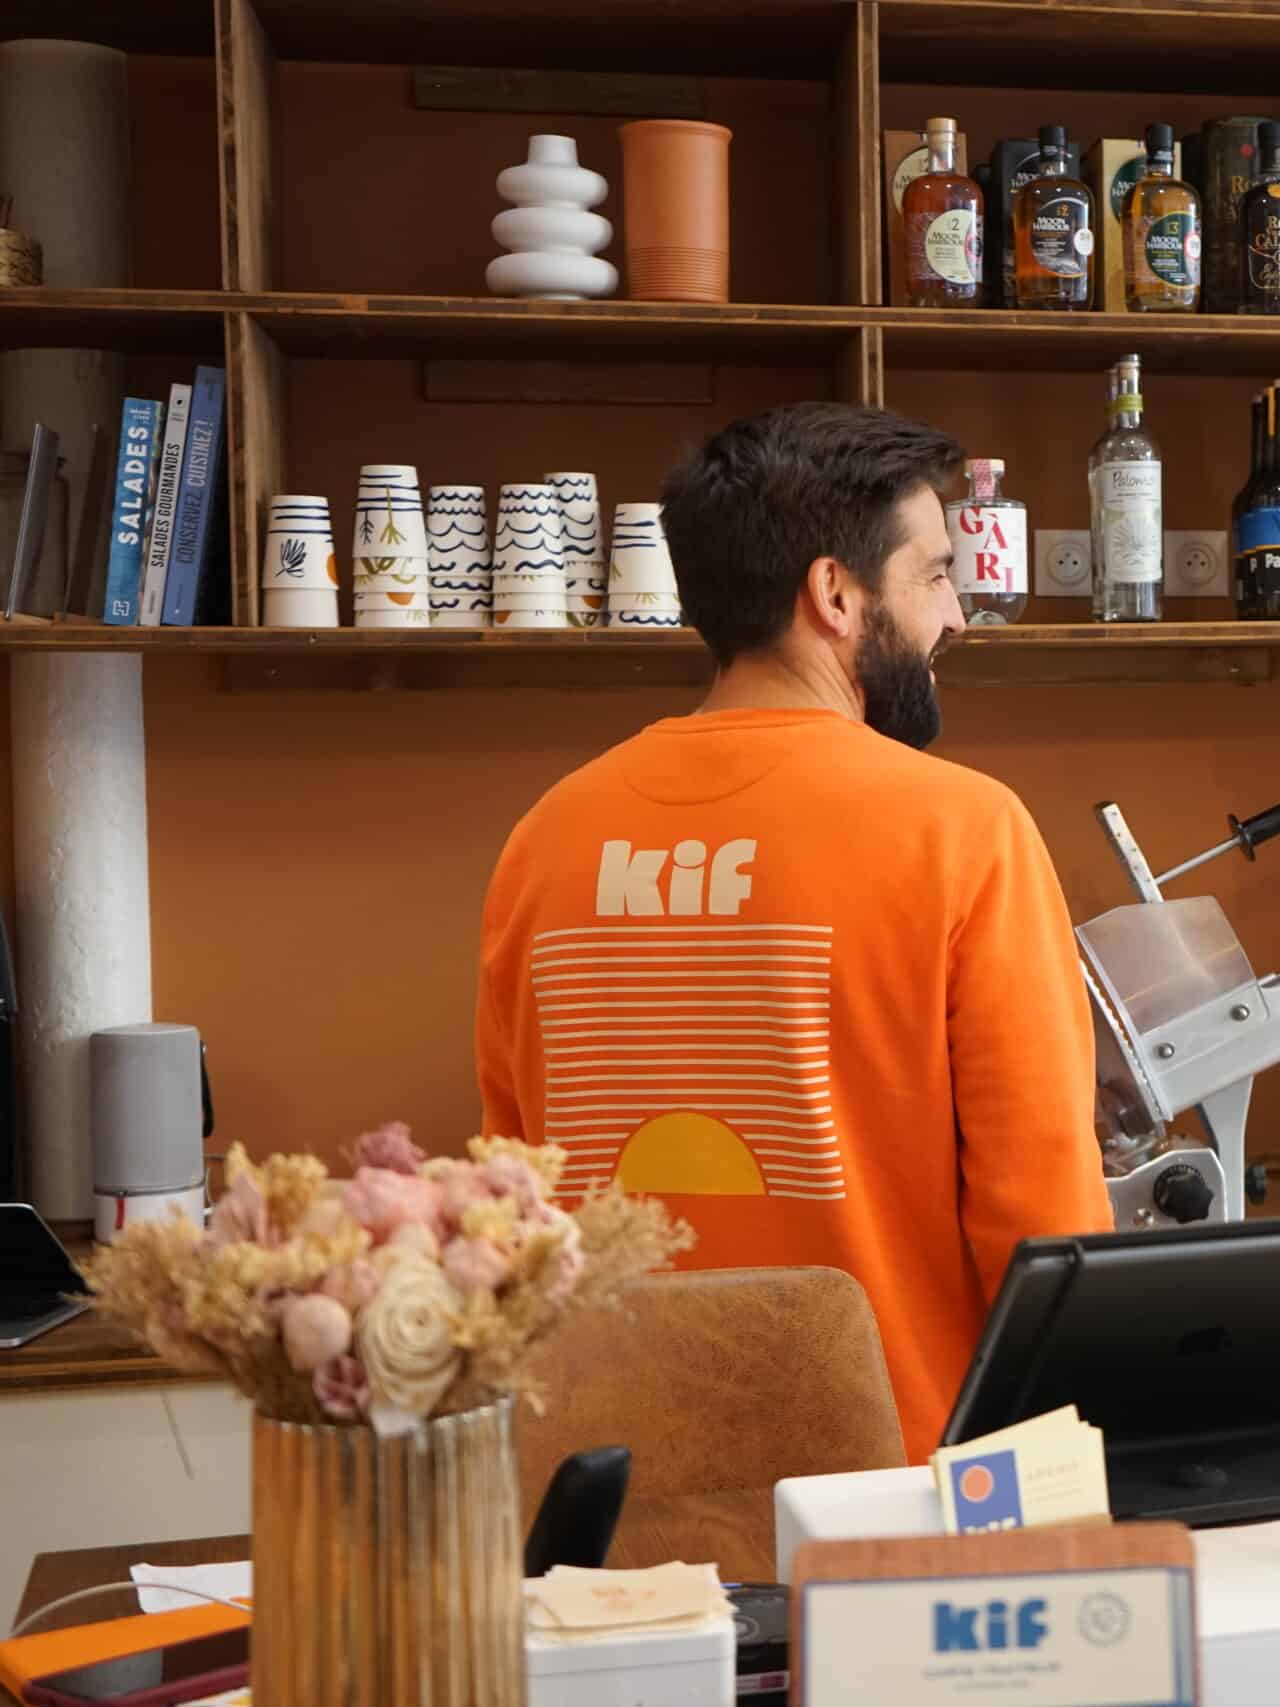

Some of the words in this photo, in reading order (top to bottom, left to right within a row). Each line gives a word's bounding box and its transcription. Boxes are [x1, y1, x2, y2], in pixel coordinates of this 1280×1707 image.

[118, 426, 149, 545] SALADES
[158, 442, 181, 517] GOURMANDES
[151, 518, 170, 568] SALADES
[595, 838, 758, 916] kif
[934, 1597, 1050, 1653] kif
